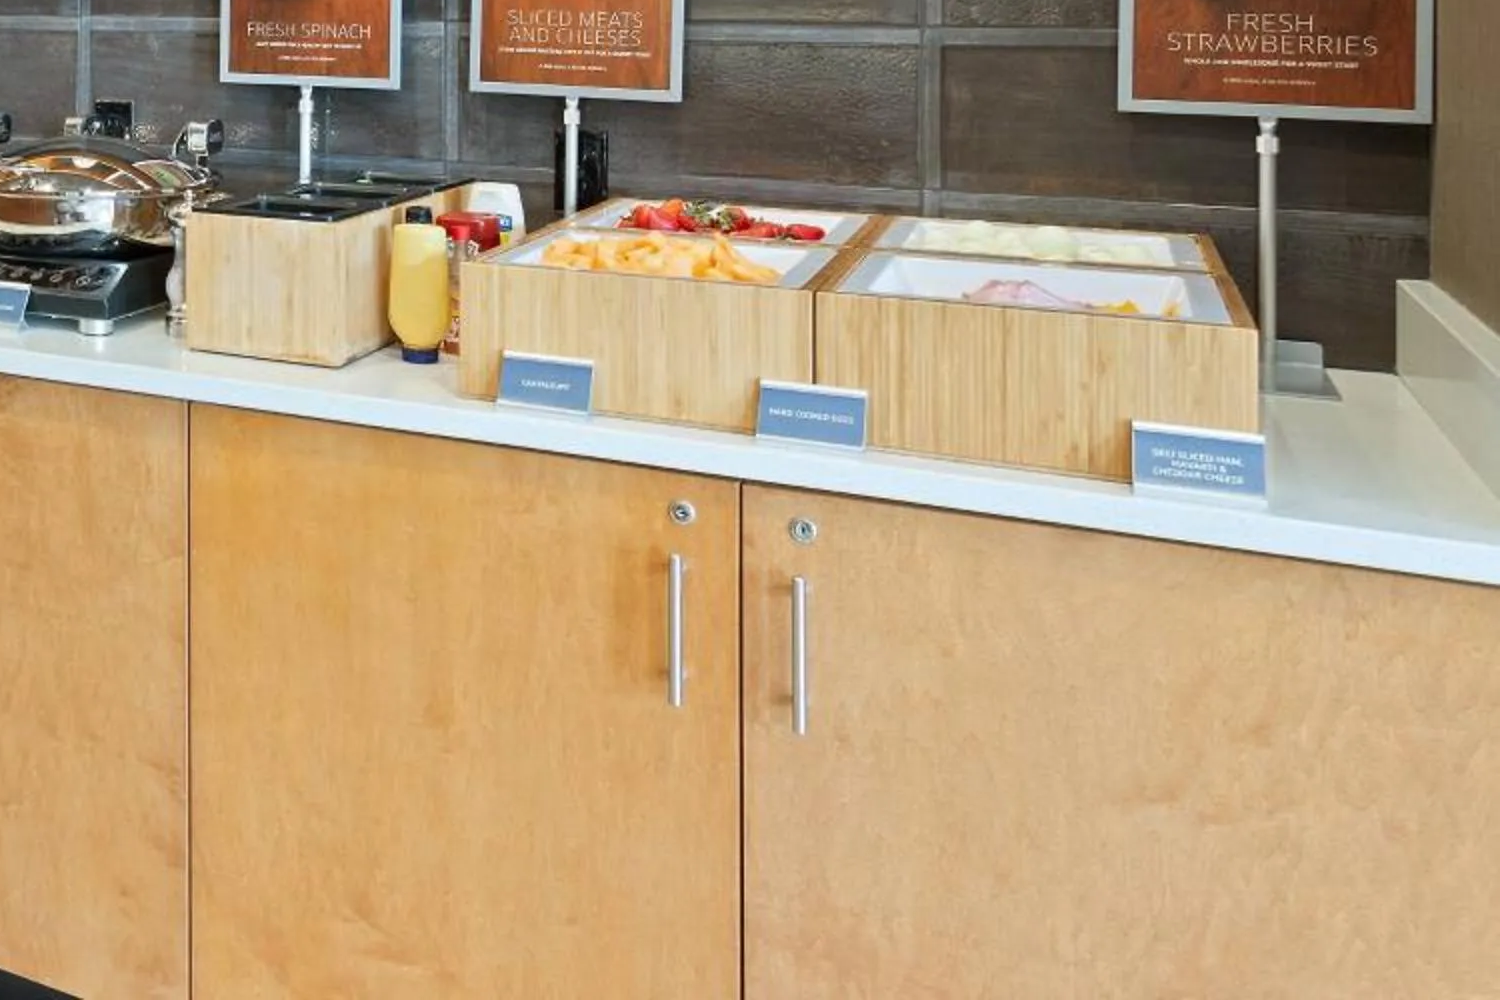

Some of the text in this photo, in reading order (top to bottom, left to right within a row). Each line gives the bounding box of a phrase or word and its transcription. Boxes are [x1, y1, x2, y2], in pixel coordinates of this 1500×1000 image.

[507, 9, 643, 29] SLICED MEATS
[1227, 13, 1313, 33] FRESH
[247, 21, 372, 40] FRESH SPINACH
[509, 26, 641, 47] AND CHEESES
[1167, 32, 1378, 57] STRAWBERRIES
